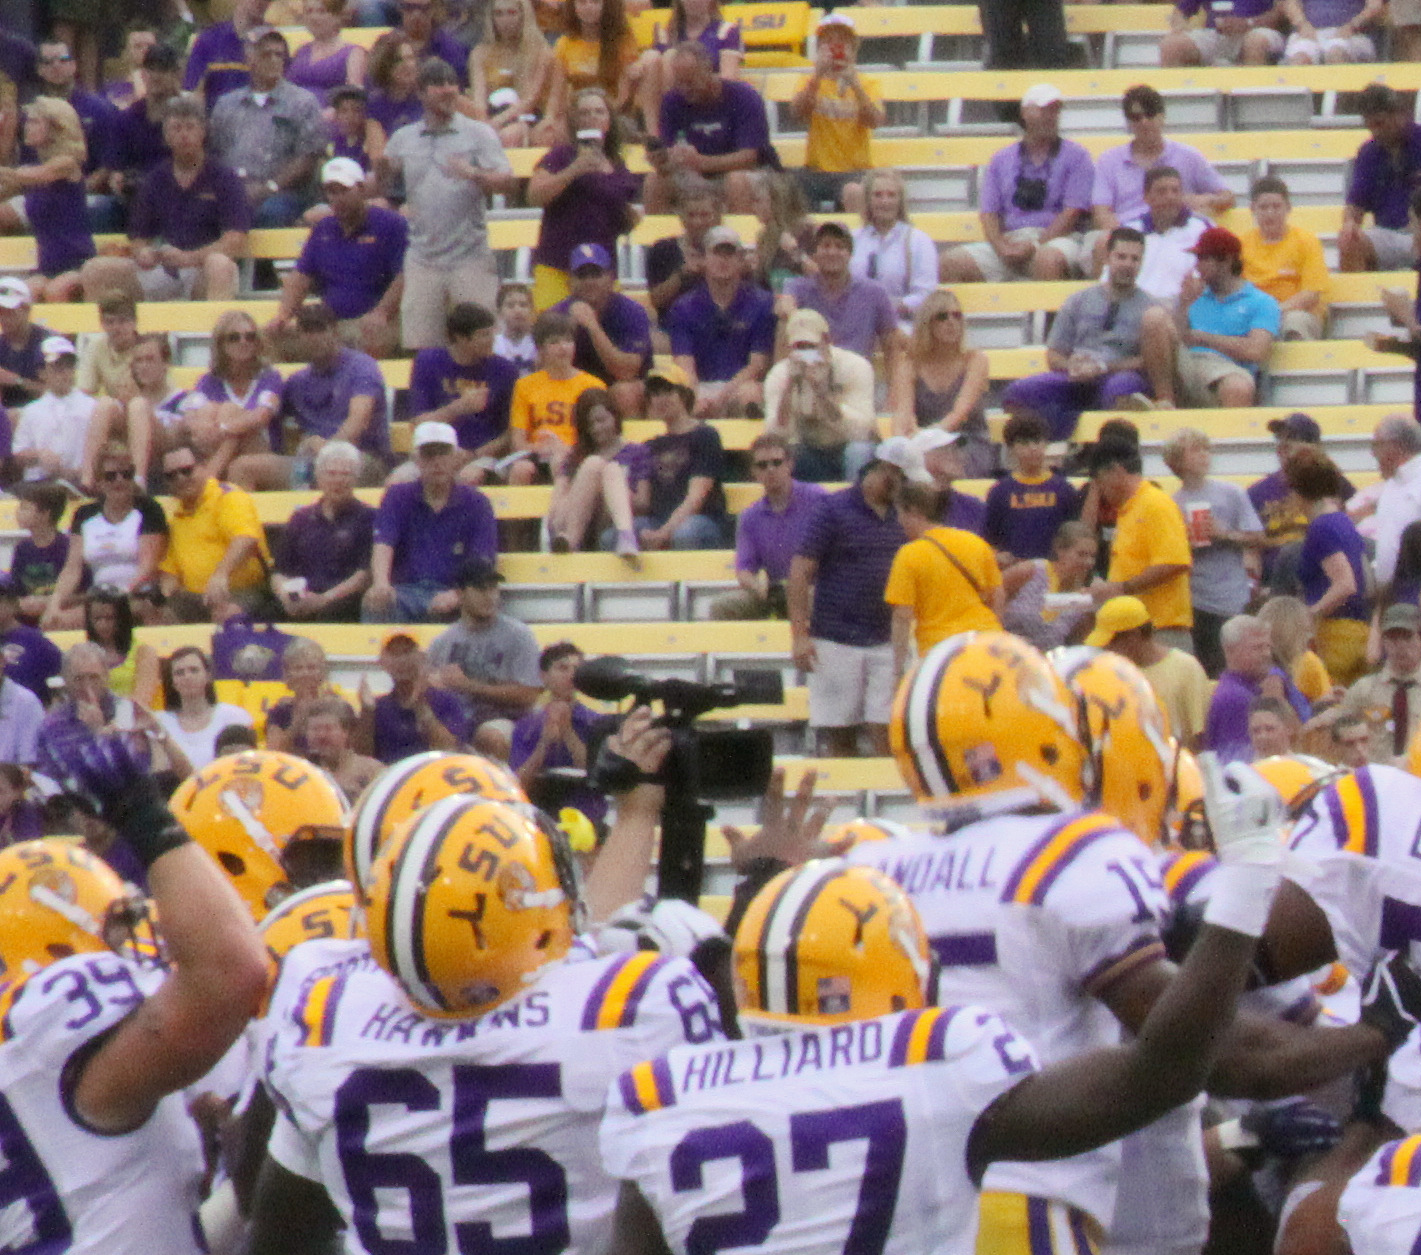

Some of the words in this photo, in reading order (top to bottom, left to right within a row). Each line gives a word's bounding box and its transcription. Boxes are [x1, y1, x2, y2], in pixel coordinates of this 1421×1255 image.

[876, 847, 998, 898] NDALL
[360, 992, 549, 1047] HANS
[682, 1025, 882, 1094] HILLIARD
